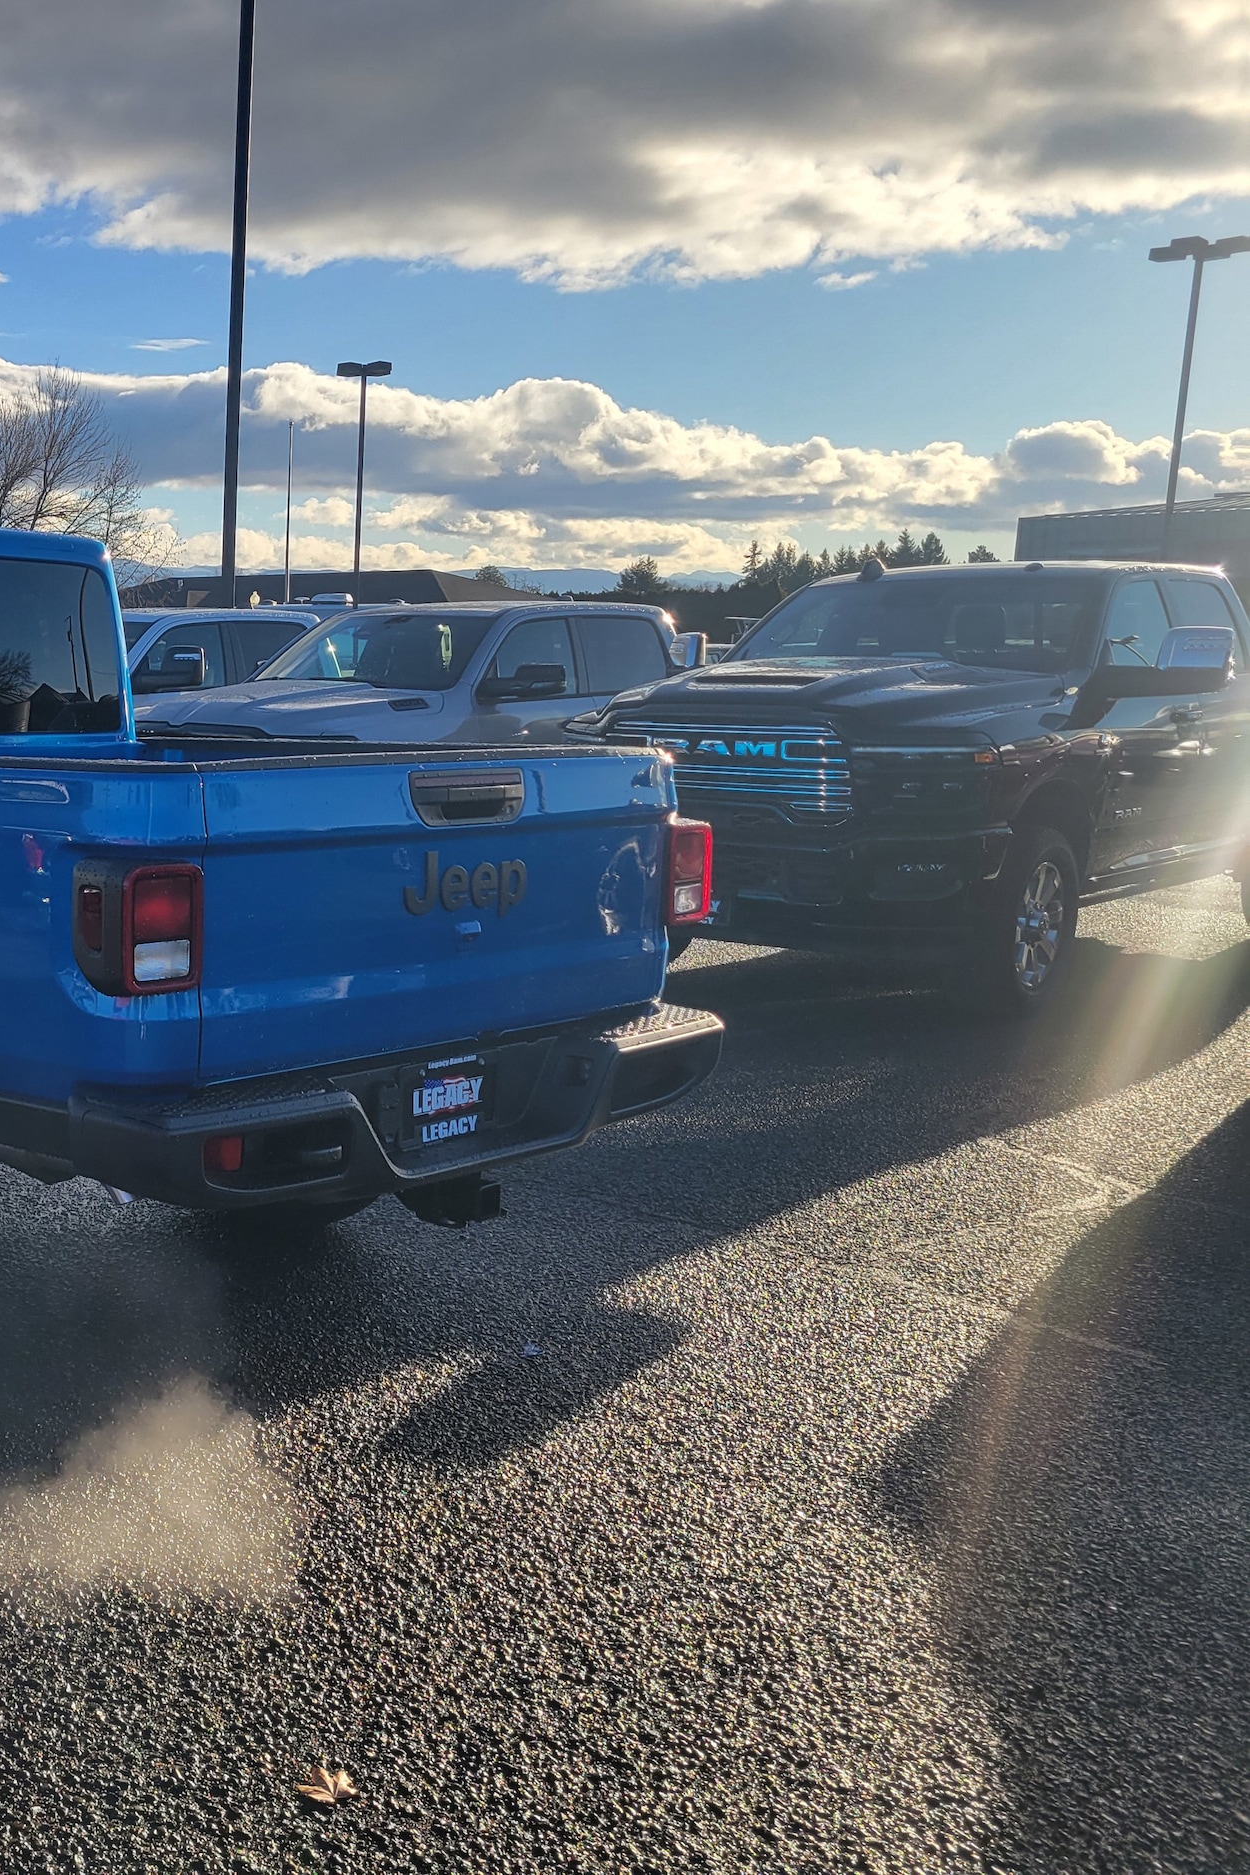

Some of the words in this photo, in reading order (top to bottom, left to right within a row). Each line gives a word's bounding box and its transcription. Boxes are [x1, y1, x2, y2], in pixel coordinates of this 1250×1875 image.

[653, 738, 777, 758] RAM
[1115, 807, 1143, 820] RAM
[403, 850, 528, 919] Jeep
[412, 1077, 484, 1115] LEGACY
[422, 1115, 479, 1143] LEGACY
